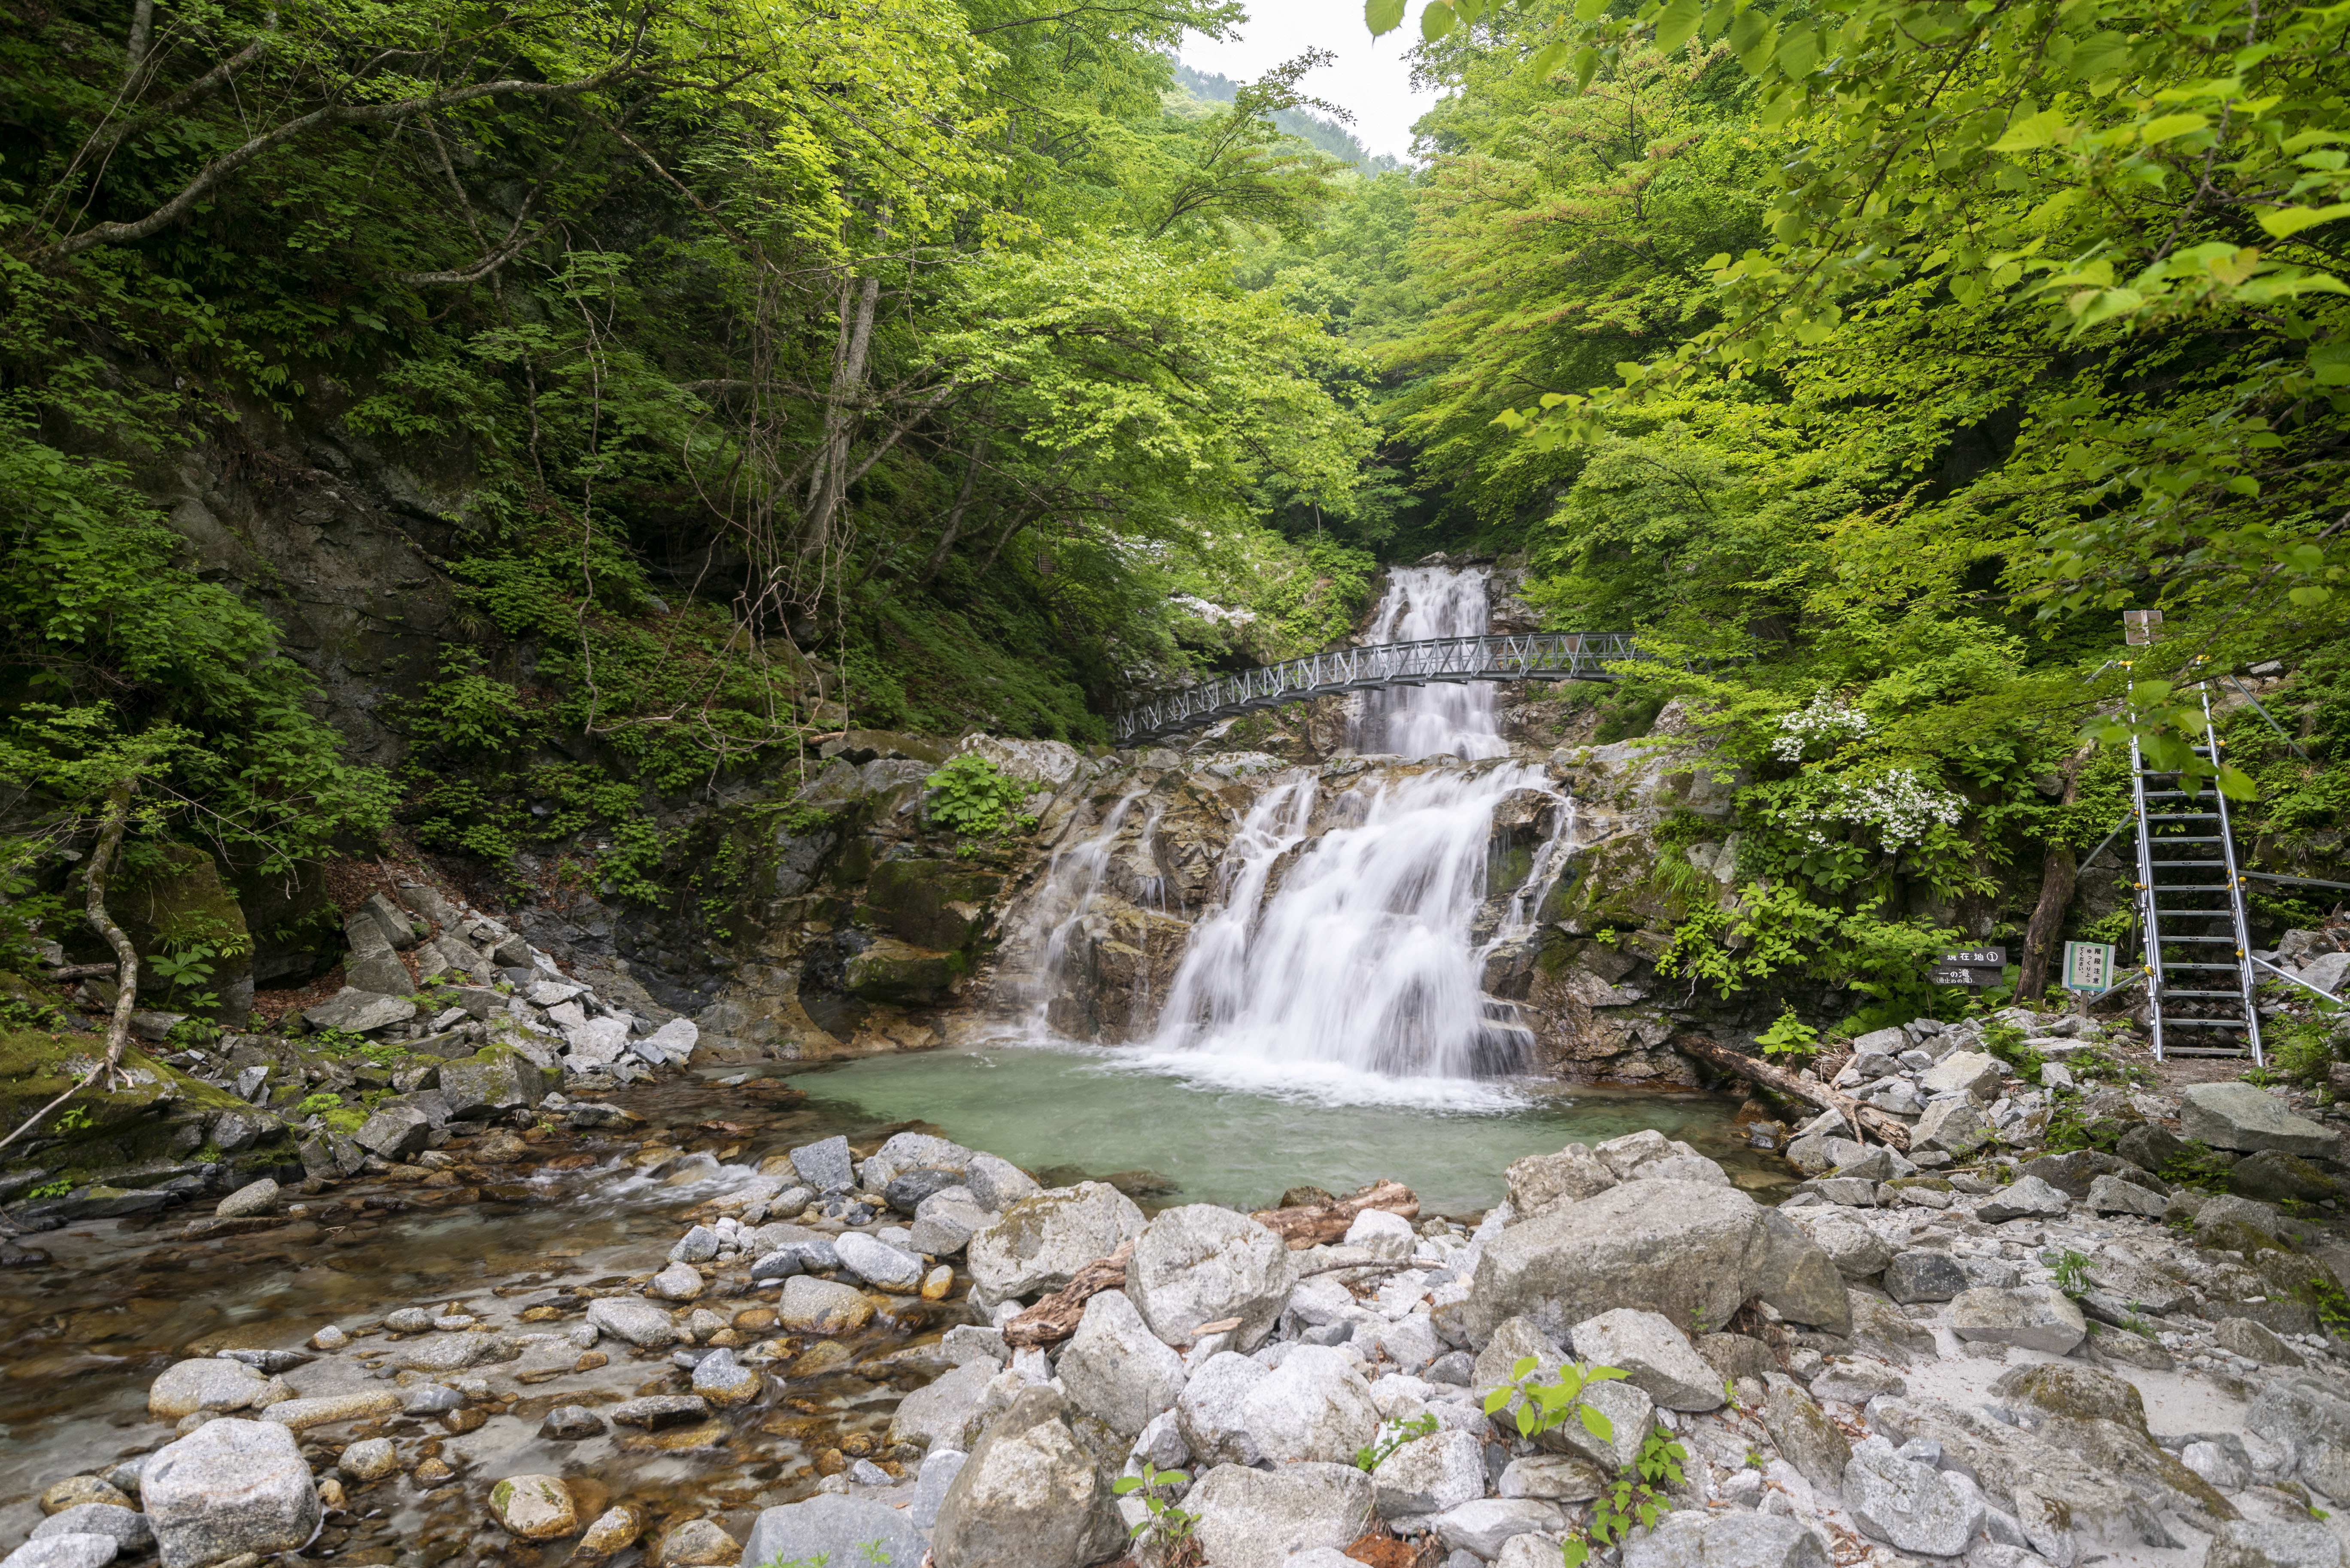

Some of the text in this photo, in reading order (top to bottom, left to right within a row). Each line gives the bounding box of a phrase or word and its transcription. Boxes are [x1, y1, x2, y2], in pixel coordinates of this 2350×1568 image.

[1938, 969, 1970, 978] 一の滝
[2092, 948, 2101, 984] 階段注意
